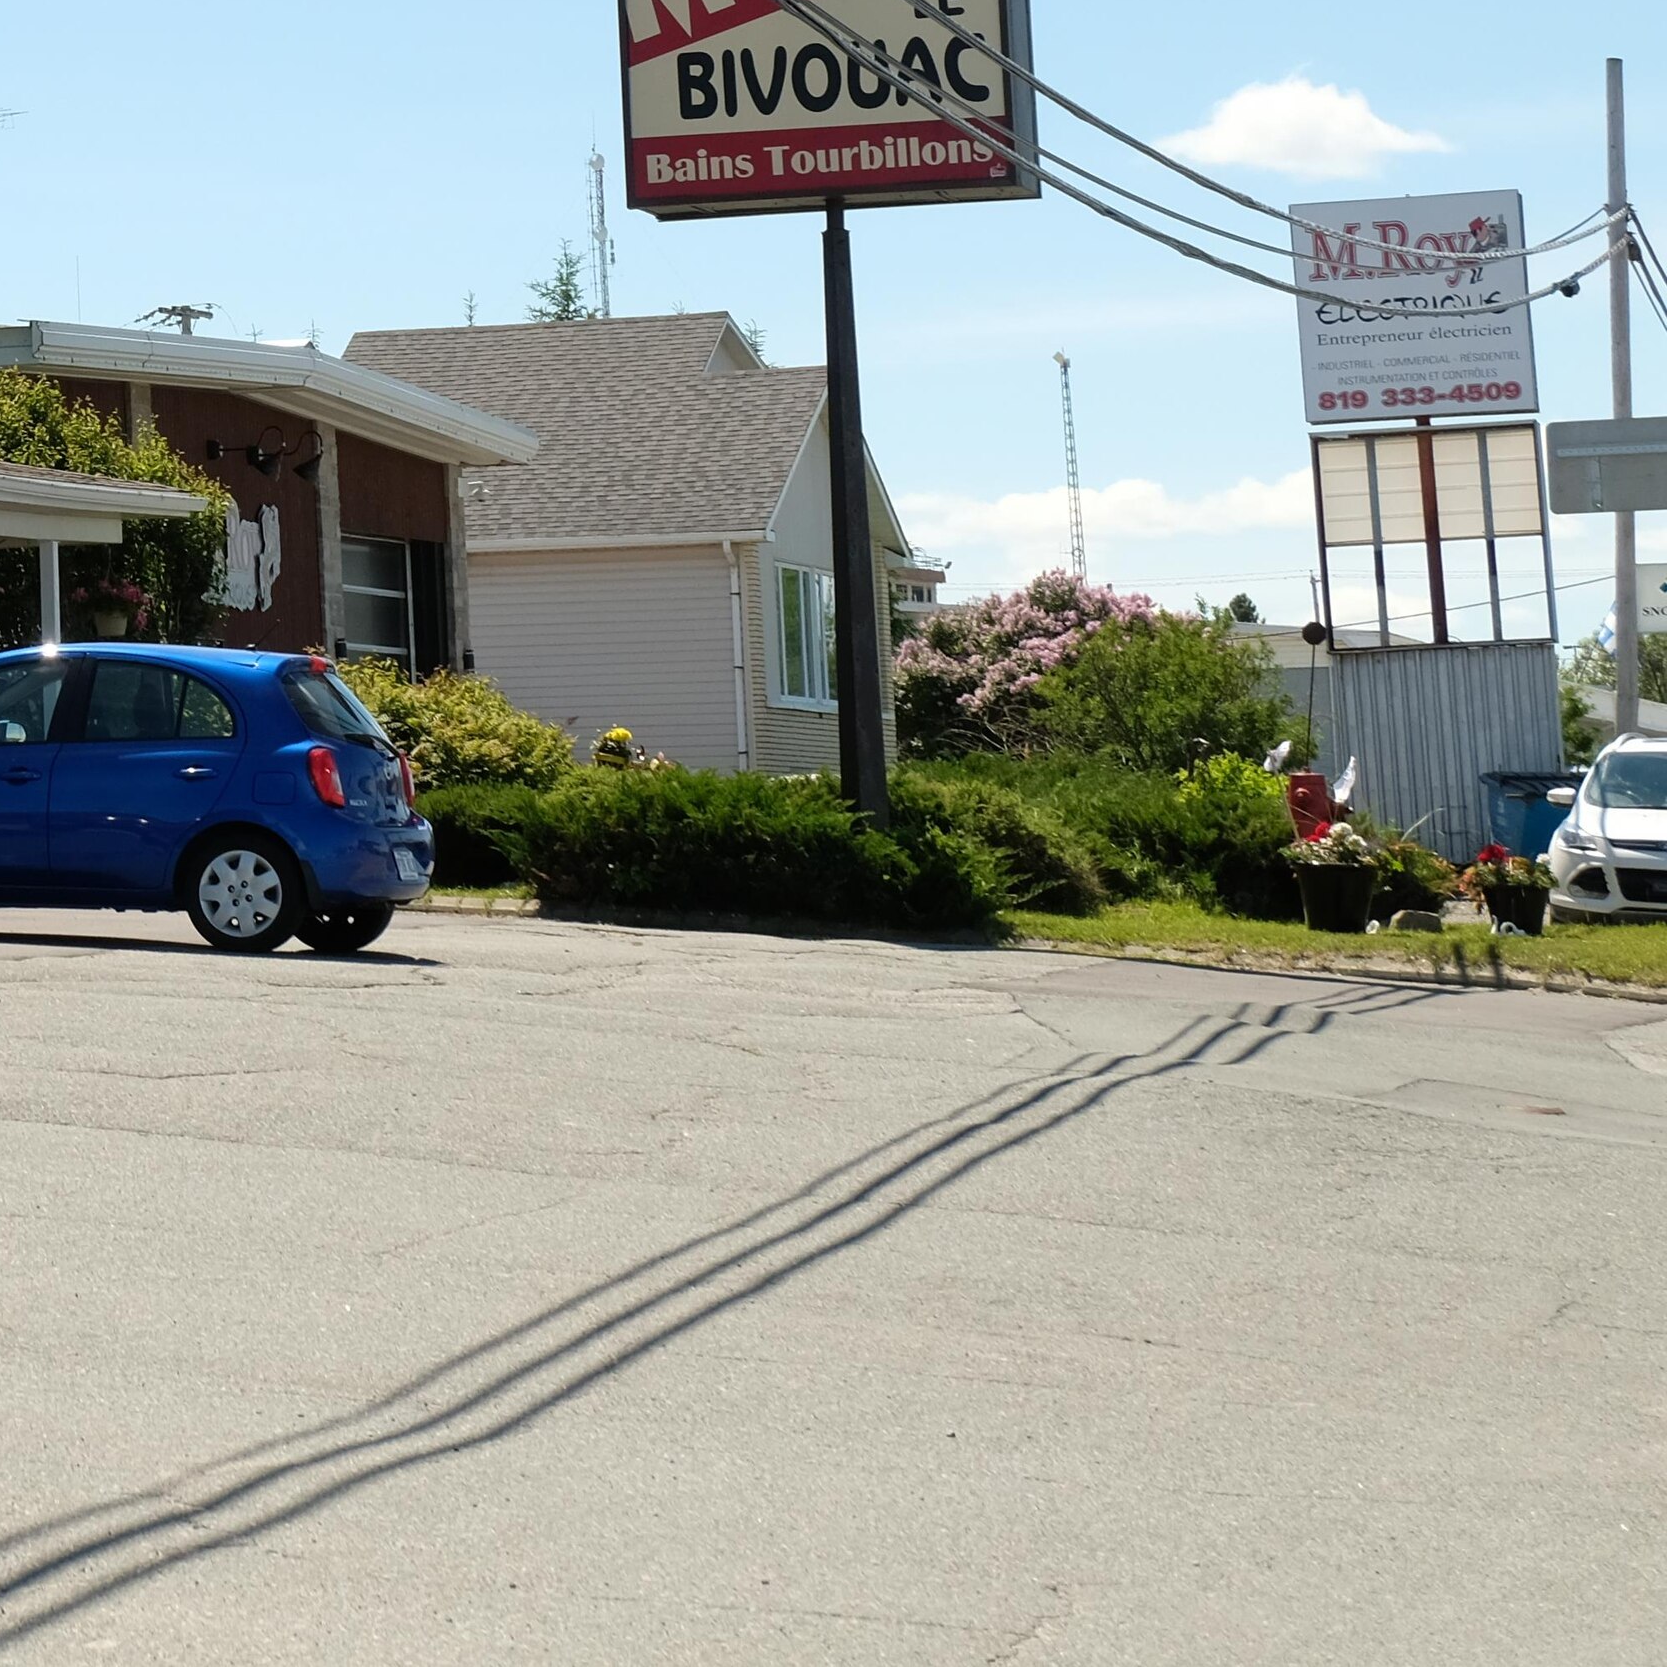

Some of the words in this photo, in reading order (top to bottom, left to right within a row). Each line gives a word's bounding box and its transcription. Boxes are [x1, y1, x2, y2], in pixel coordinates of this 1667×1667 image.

[677, 33, 990, 120] BIVOUAC
[645, 149, 754, 184] Bains
[763, 135, 994, 177] Tourbillons
[1317, 331, 1424, 347] Entrepreneur
[1428, 324, 1513, 341] électricien
[1428, 371, 1439, 381] ET
[1317, 389, 1369, 411] 819
[1380, 380, 1522, 408] 333-4509
